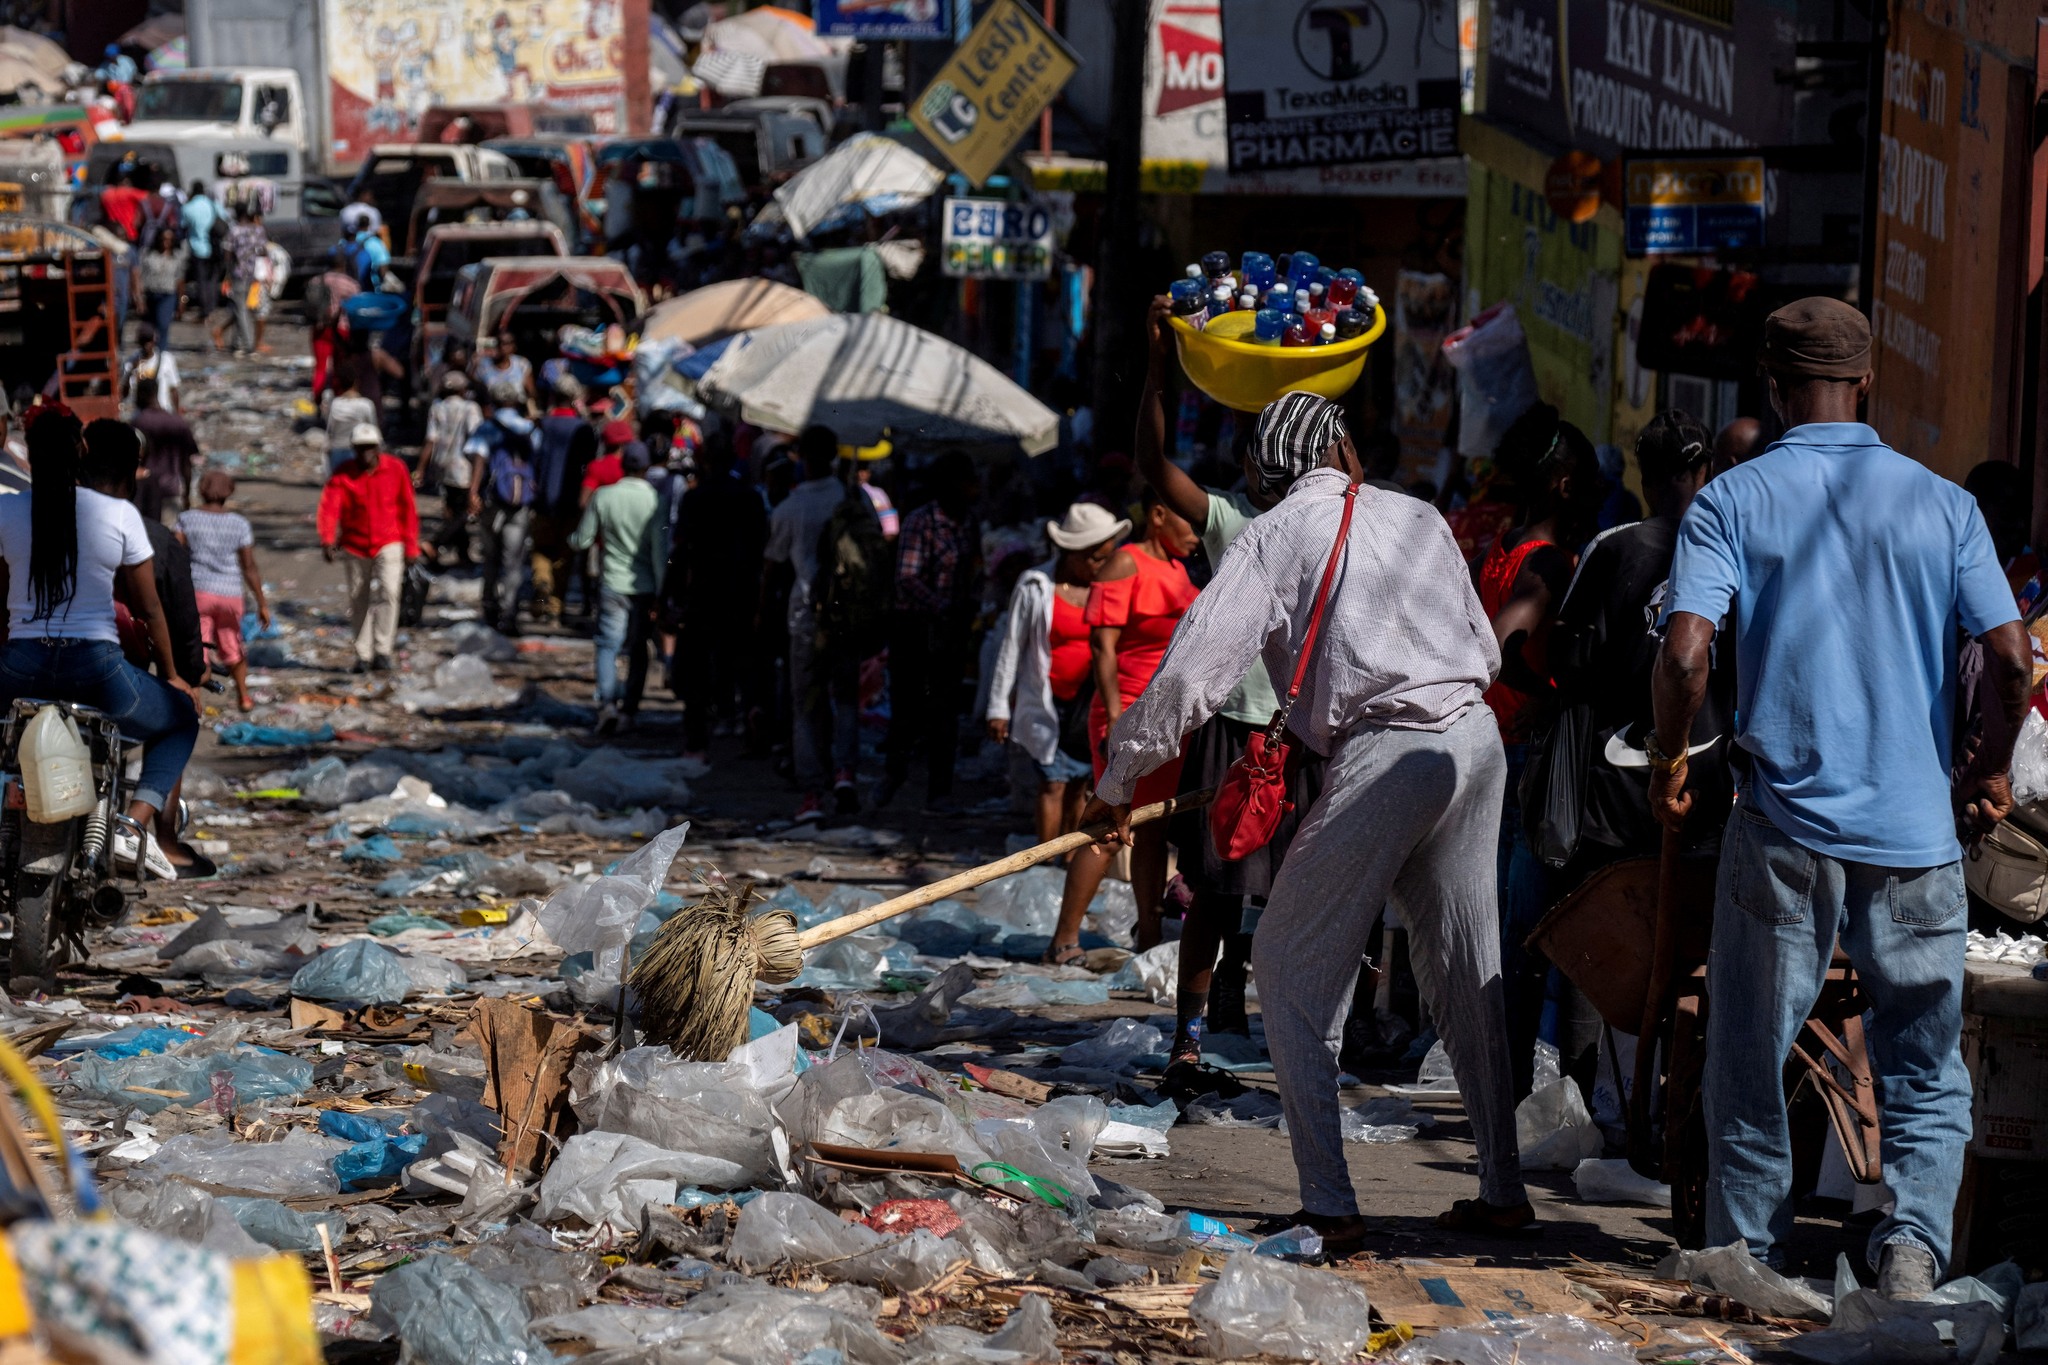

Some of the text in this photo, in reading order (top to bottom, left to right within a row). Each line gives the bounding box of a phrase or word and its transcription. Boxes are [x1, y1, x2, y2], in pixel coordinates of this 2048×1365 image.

[957, 9, 1031, 88] Lesly
[985, 42, 1053, 122] Center
[1605, 0, 1737, 118] KAY LYNN
[1231, 116, 1318, 139] PRODUITS
[1322, 106, 1453, 134] COSMETIQUES
[1276, 84, 1408, 110] TexaMedia
[1572, 67, 1654, 150] PRODUITS
[1232, 126, 1456, 167] PHARMACIE
[1900, 144, 1949, 243] OPTIK
[1990, 1122, 2031, 1136] 03011
